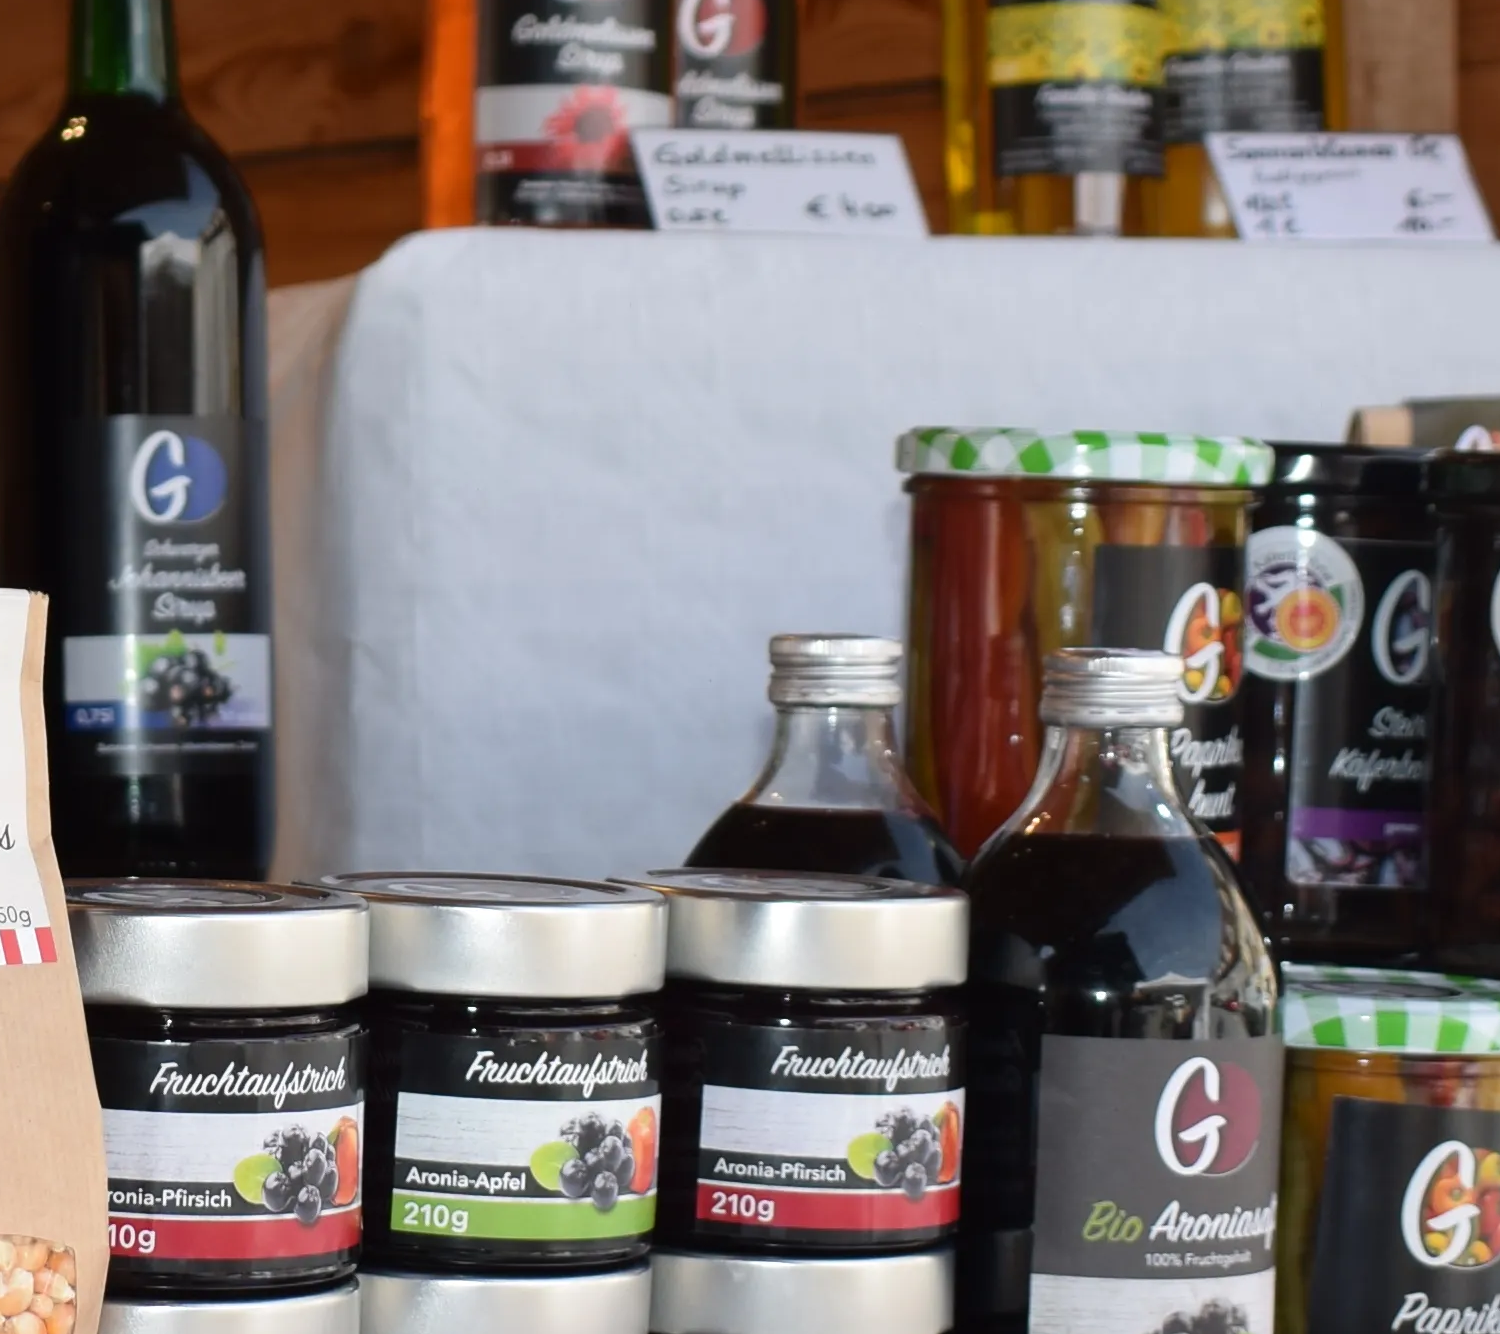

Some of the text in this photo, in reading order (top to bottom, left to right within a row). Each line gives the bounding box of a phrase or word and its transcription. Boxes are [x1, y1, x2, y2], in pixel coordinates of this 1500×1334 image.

[131, 430, 191, 524] G
[148, 1056, 347, 1109] Fruchtaufstrich
[465, 1050, 649, 1099] Fruchtaufstrich
[771, 1045, 951, 1091] Fruchtaufstrich
[1155, 1056, 1228, 1175] G
[405, 1166, 527, 1193] Aronia-Apfel
[713, 1156, 846, 1183] Aronia-Pfirsich
[107, 1188, 232, 1208] ronia-Pfirsich
[403, 1200, 470, 1233] 210g
[711, 1191, 774, 1223] 210g
[1403, 1139, 1481, 1266] G
[108, 1223, 156, 1254] 10g
[1082, 1199, 1144, 1243] Bio
[1145, 1252, 1183, 1268] 100%
